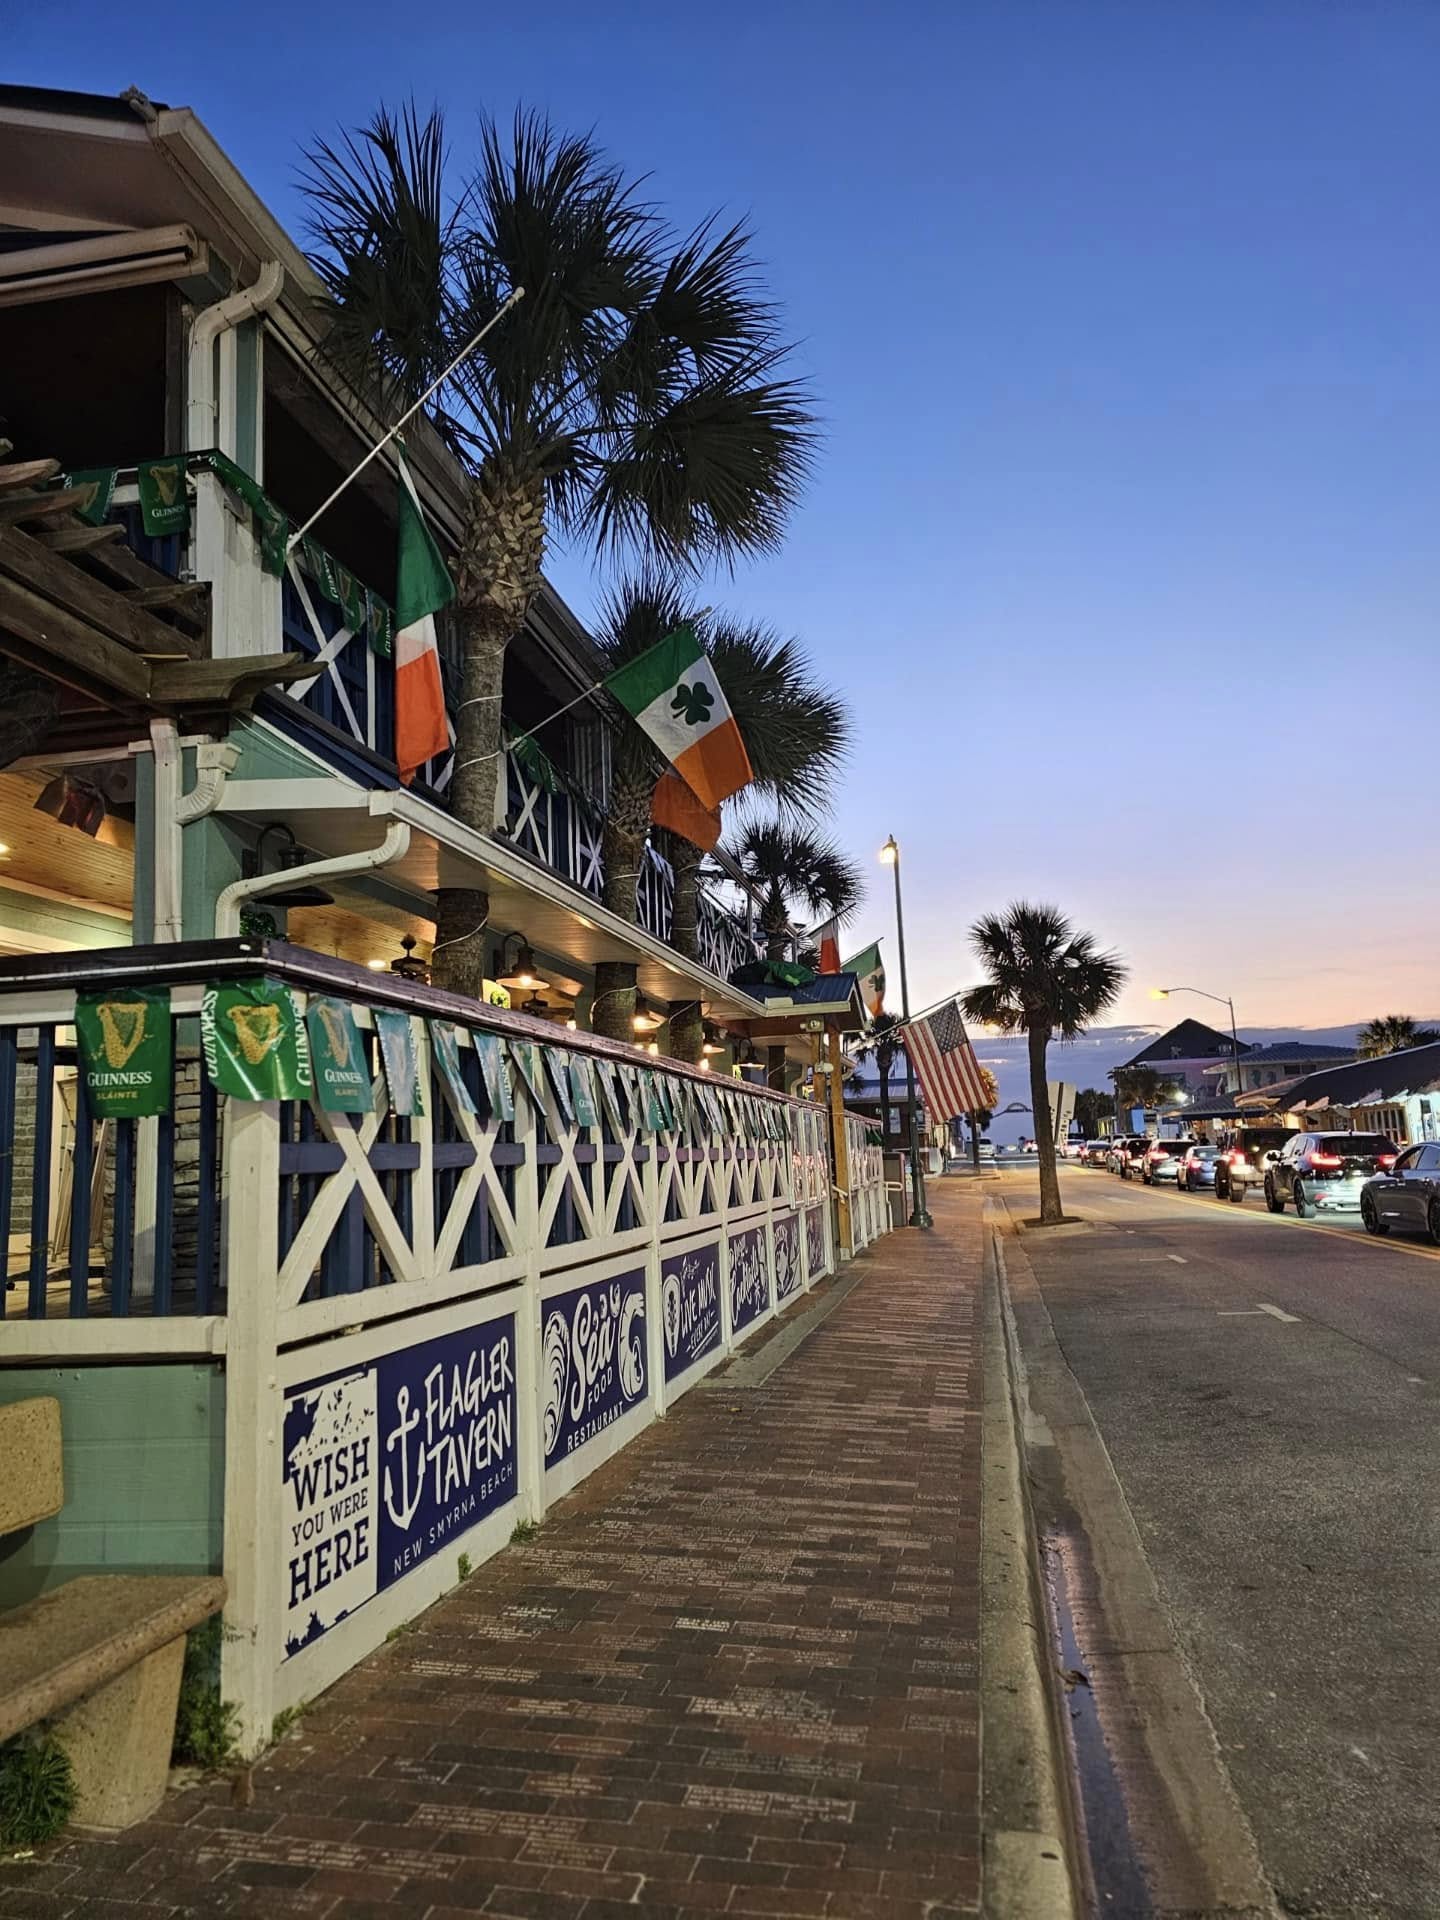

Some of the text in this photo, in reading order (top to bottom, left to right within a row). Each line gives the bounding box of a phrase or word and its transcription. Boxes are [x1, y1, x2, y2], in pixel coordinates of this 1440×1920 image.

[87, 1071, 152, 1087] GUINNESS
[680, 1288, 698, 1340] LIVE
[424, 1336, 514, 1446] FLAGLER
[570, 1293, 615, 1423] Sea
[587, 1366, 614, 1413] FOOD
[426, 1394, 512, 1505] TAVERN
[567, 1401, 624, 1453] RESTAURANT
[291, 1436, 370, 1512] WISH
[292, 1487, 369, 1547] YOU WERE
[393, 1462, 514, 1575] NEW SMYRNA BEACH
[288, 1516, 369, 1610] HERE
